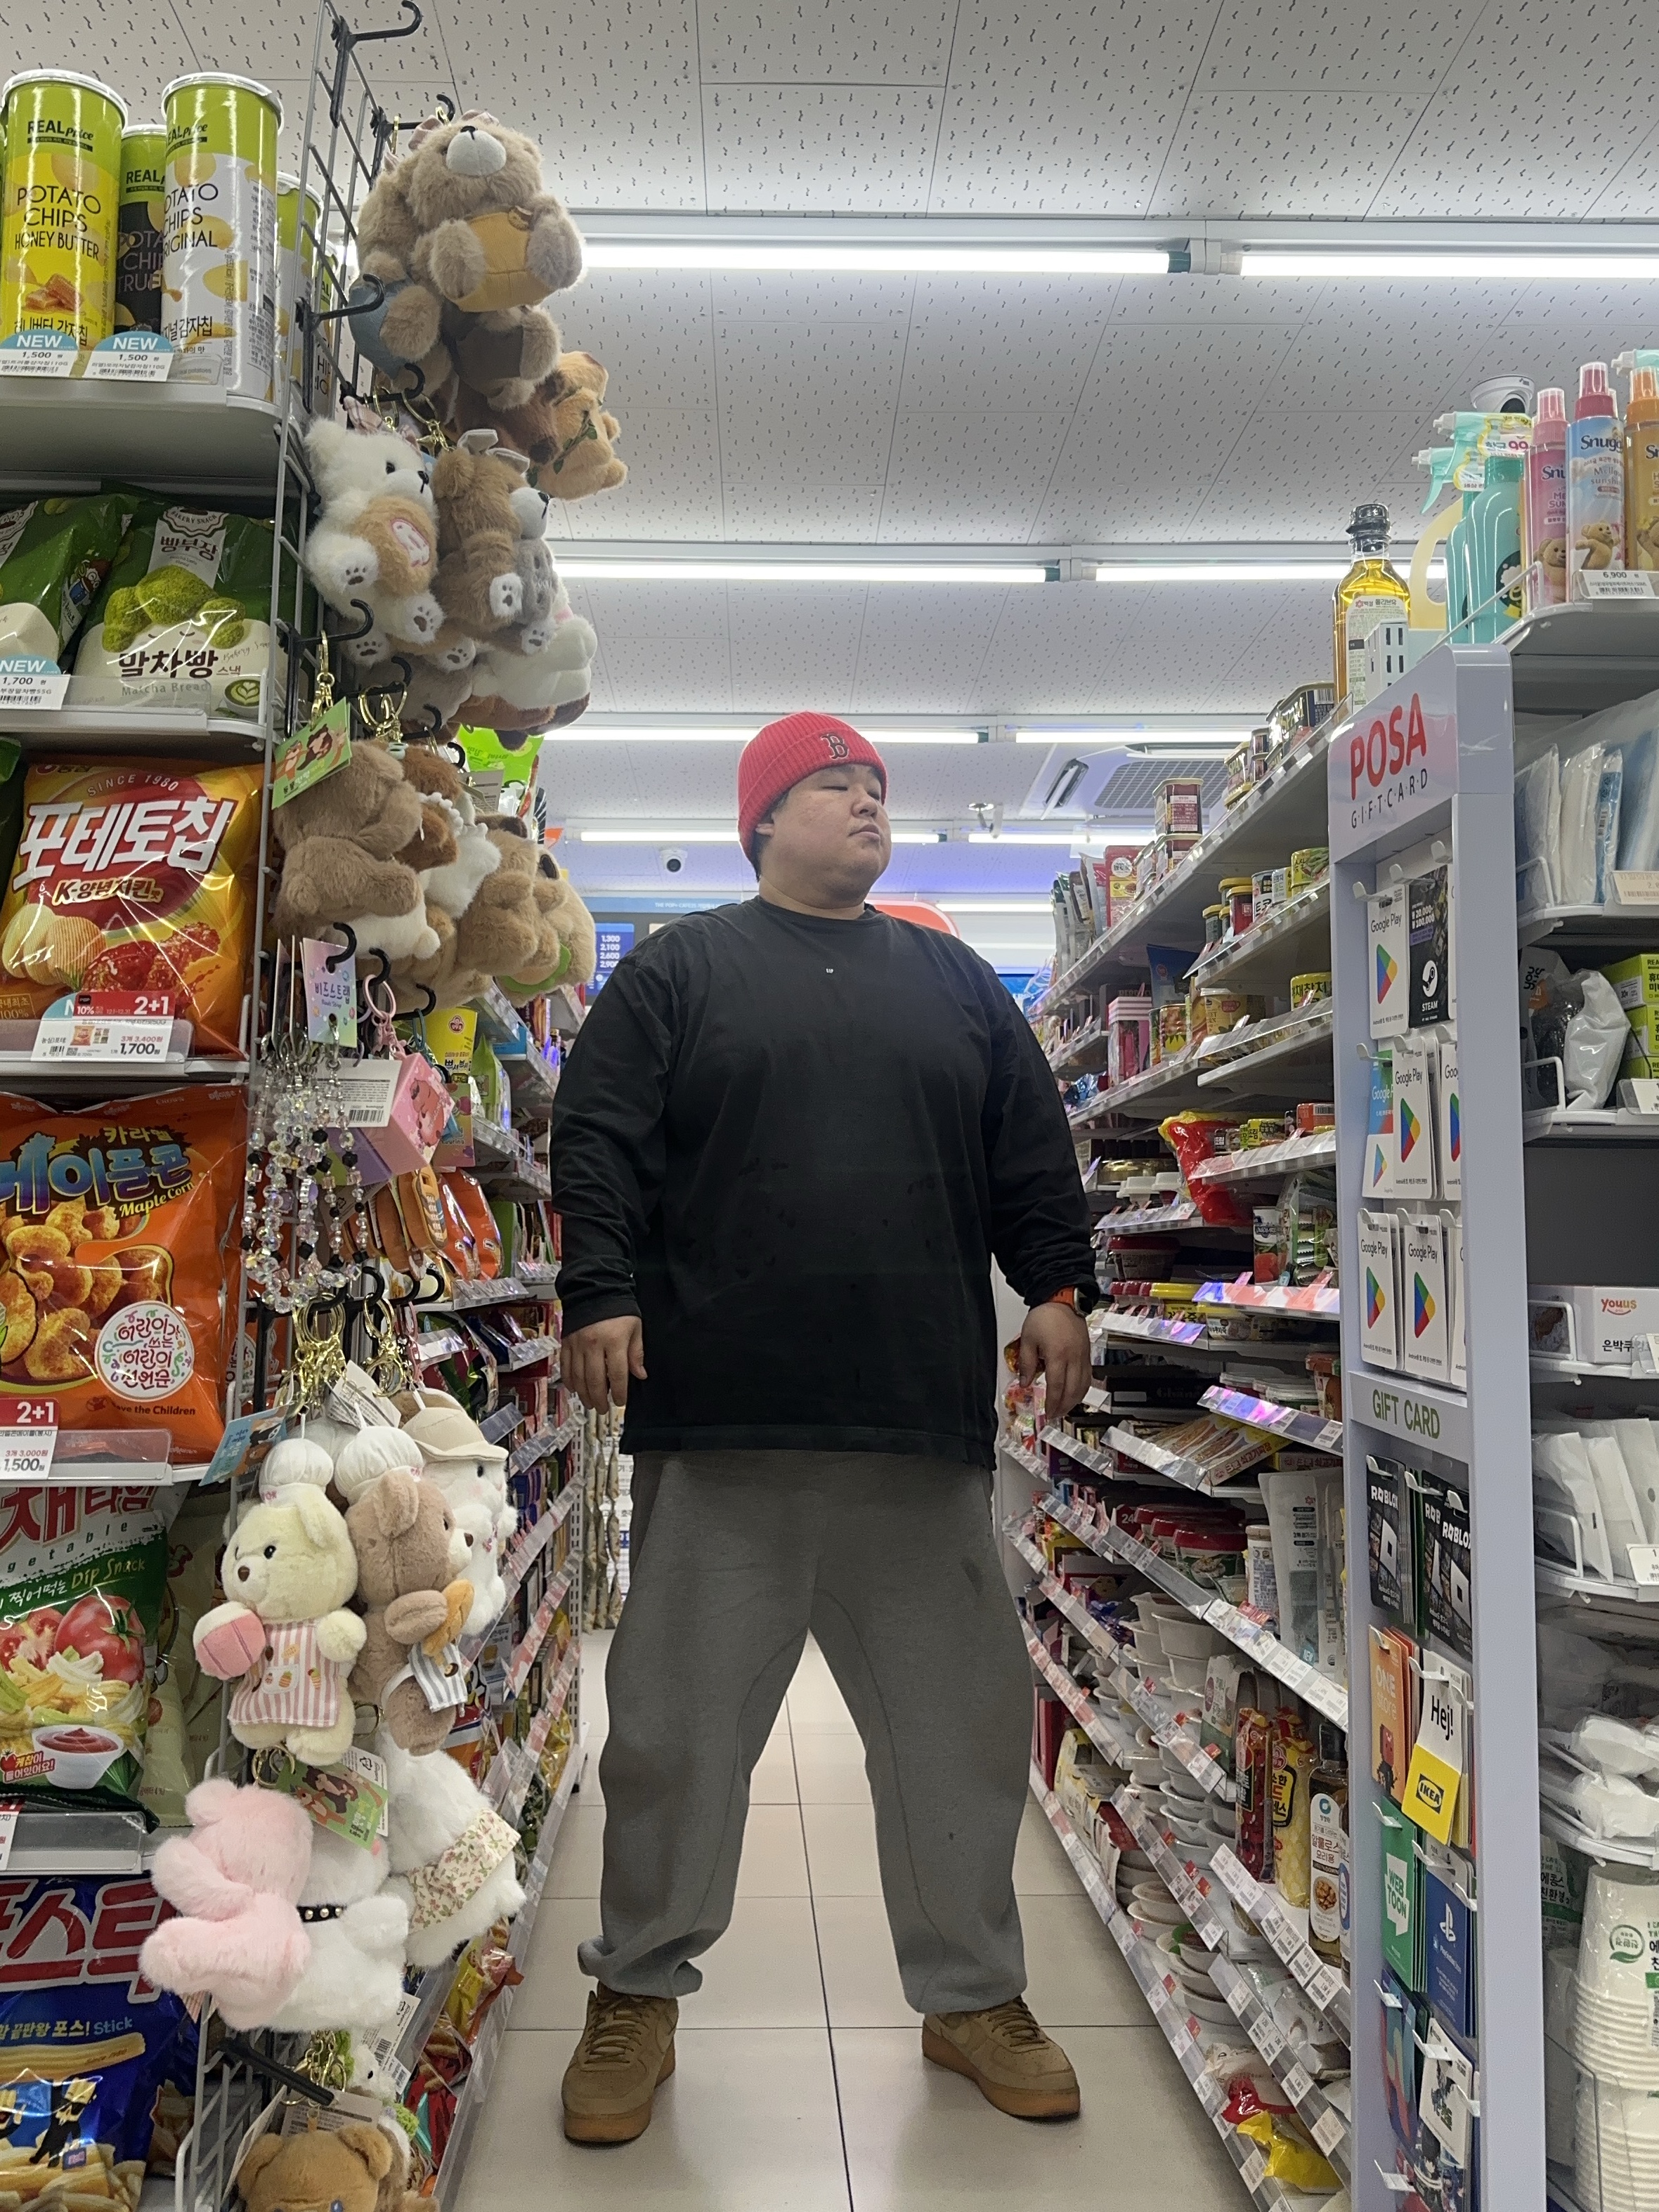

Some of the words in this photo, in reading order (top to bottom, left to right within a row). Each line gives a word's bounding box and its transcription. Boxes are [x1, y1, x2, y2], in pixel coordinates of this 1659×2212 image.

[17, 185, 101, 214] POTATO
[23, 207, 88, 233] CHIPS
[14, 230, 56, 251] HONEY
[58, 232, 100, 261] BUTTER
[178, 315, 213, 338] 감자칩
[17, 334, 63, 348] NEW
[112, 336, 159, 351] NEW
[160, 536, 217, 561] 빵부장
[0, 660, 47, 672] NEW
[216, 665, 241, 676] 스낵
[820, 733, 850, 760] B
[1349, 692, 1428, 800] POSA
[87, 773, 136, 797] SINCE
[145, 774, 179, 792] 1980
[13, 795, 235, 892] 포테토칩
[1370, 916, 1390, 933] Google
[1390, 913, 1403, 928] Play
[134, 995, 169, 1015] 2+1
[1421, 1001, 1438, 1013] STEAM
[1395, 1069, 1413, 1087] Google
[1412, 1067, 1423, 1084] Play
[1372, 1084, 1389, 1103] Google
[103, 1125, 174, 1146] 카라멜
[119, 1195, 167, 1218] Maple
[167, 1180, 195, 1200] Corn
[1360, 1239, 1378, 1257] Google
[1377, 1241, 1388, 1259] Play
[1407, 1242, 1428, 1262] Google
[1427, 1244, 1438, 1263] Play
[1601, 1298, 1638, 1313] youus
[123, 1348, 173, 1370] 어린이
[16, 1401, 55, 1424] 2+1
[134, 1405, 151, 1414] the
[152, 1405, 196, 1415] Children
[1372, 1388, 1400, 1426] GIFT
[1403, 1398, 1440, 1440] CARD
[71, 1568, 100, 1589] Dip
[103, 1557, 145, 1580] Snack
[1375, 1664, 1396, 1699] ONE
[1376, 1691, 1398, 1721] store
[1431, 1694, 1454, 1741] Hej!
[1419, 1781, 1442, 1806] IKEA
[1388, 1868, 1405, 1894] WEB
[1387, 1883, 1407, 1919] TOON
[52, 2019, 91, 2038] 포스!
[93, 2016, 134, 2036] Stick
